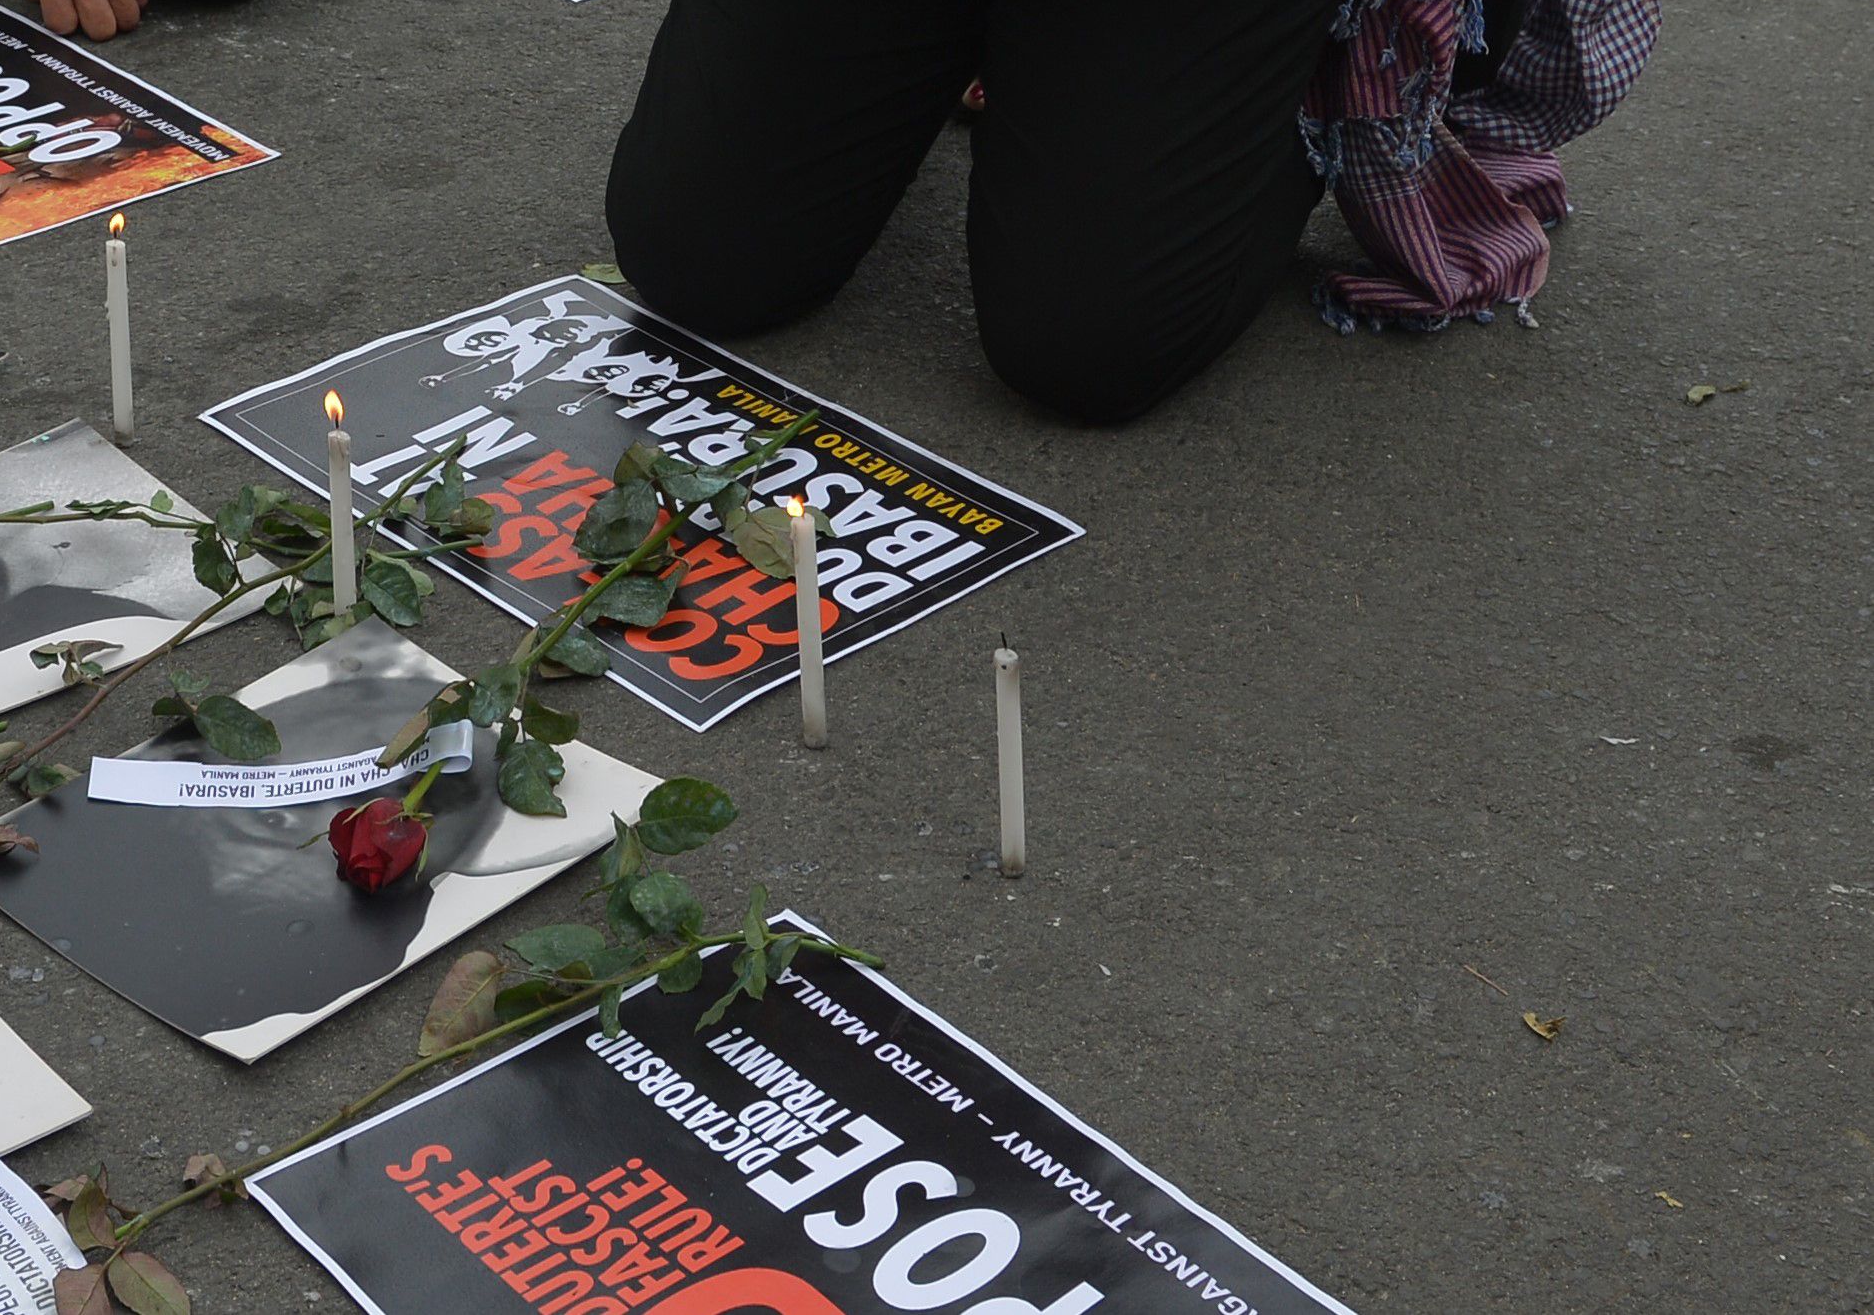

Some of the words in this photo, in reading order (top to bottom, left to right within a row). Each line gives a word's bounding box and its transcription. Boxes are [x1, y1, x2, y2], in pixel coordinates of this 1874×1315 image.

[28, 51, 100, 87] TYRANNY
[84, 83, 157, 119] AGAINST
[143, 115, 232, 161] MOVEMENT
[404, 403, 542, 469] NI
[805, 431, 914, 486] METRO
[335, 437, 479, 509] AT
[608, 384, 988, 581] IBASURA!
[900, 481, 1006, 534] BAYAN
[179, 784, 255, 798] IBASURA!
[201, 770, 239, 781] MANILA
[242, 771, 276, 780] METRO
[289, 763, 334, 779] TYRANNY
[339, 774, 355, 788] NI
[764, 965, 884, 1046] MANILA
[578, 1021, 783, 1174] DICTATORSHIP
[700, 1024, 860, 1135] TYRANNY!
[867, 1040, 978, 1113] METRO
[730, 1095, 820, 1153] AND
[986, 1126, 1144, 1232] TYRANNY
[13, 1212, 50, 1244] AGAINST
[379, 1139, 632, 1314] DUTERTE'S
[486, 1158, 689, 1308] FASCIST
[582, 1155, 747, 1274] RULE!
